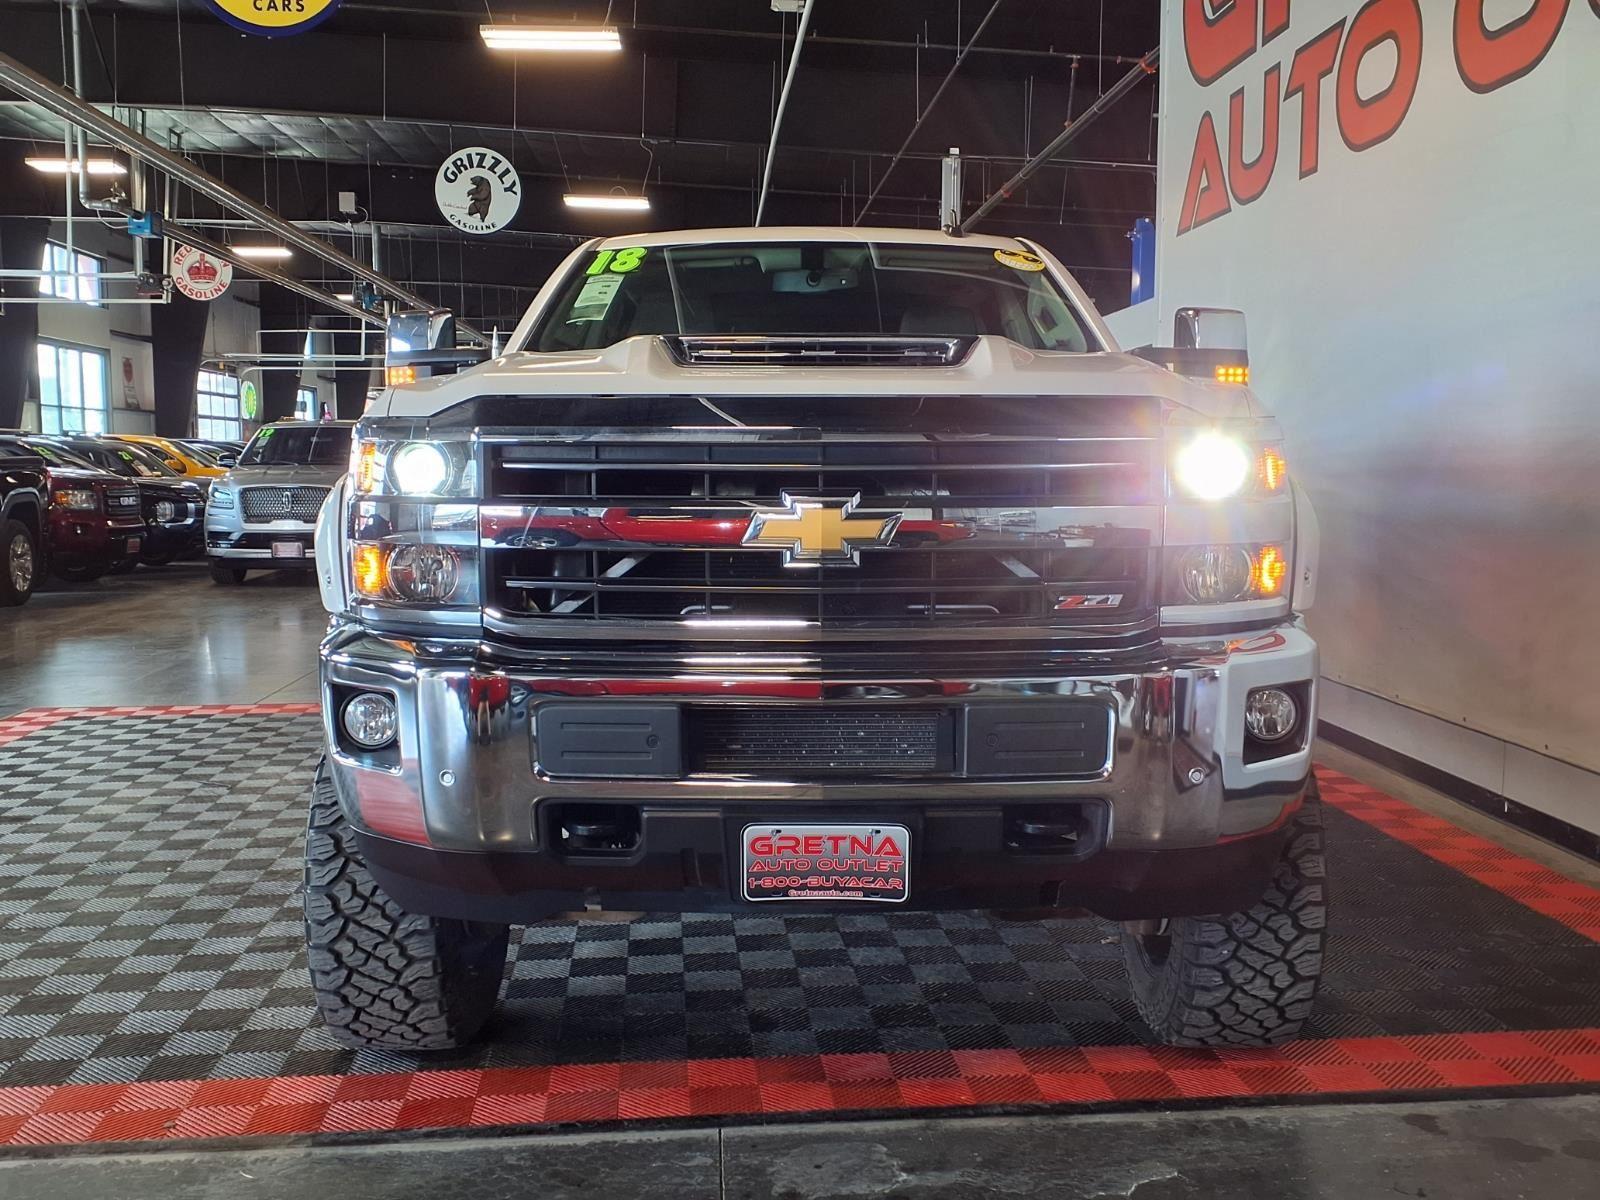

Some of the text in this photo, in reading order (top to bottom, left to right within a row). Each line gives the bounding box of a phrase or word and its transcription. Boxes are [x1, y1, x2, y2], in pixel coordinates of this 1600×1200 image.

[253, 0, 305, 12] CARS
[1176, 0, 1424, 238] AUTO
[443, 152, 518, 196] GRIZZLY
[449, 214, 497, 231] GASOLINE
[174, 246, 193, 266] RED
[586, 247, 648, 275] 18
[176, 276, 228, 299] GASOLINE
[1054, 594, 1124, 610] Z71
[749, 836, 904, 857] GRETNA
[748, 859, 904, 873] AUTO OUTLET
[748, 876, 903, 889] 1-800-BUYACAR
